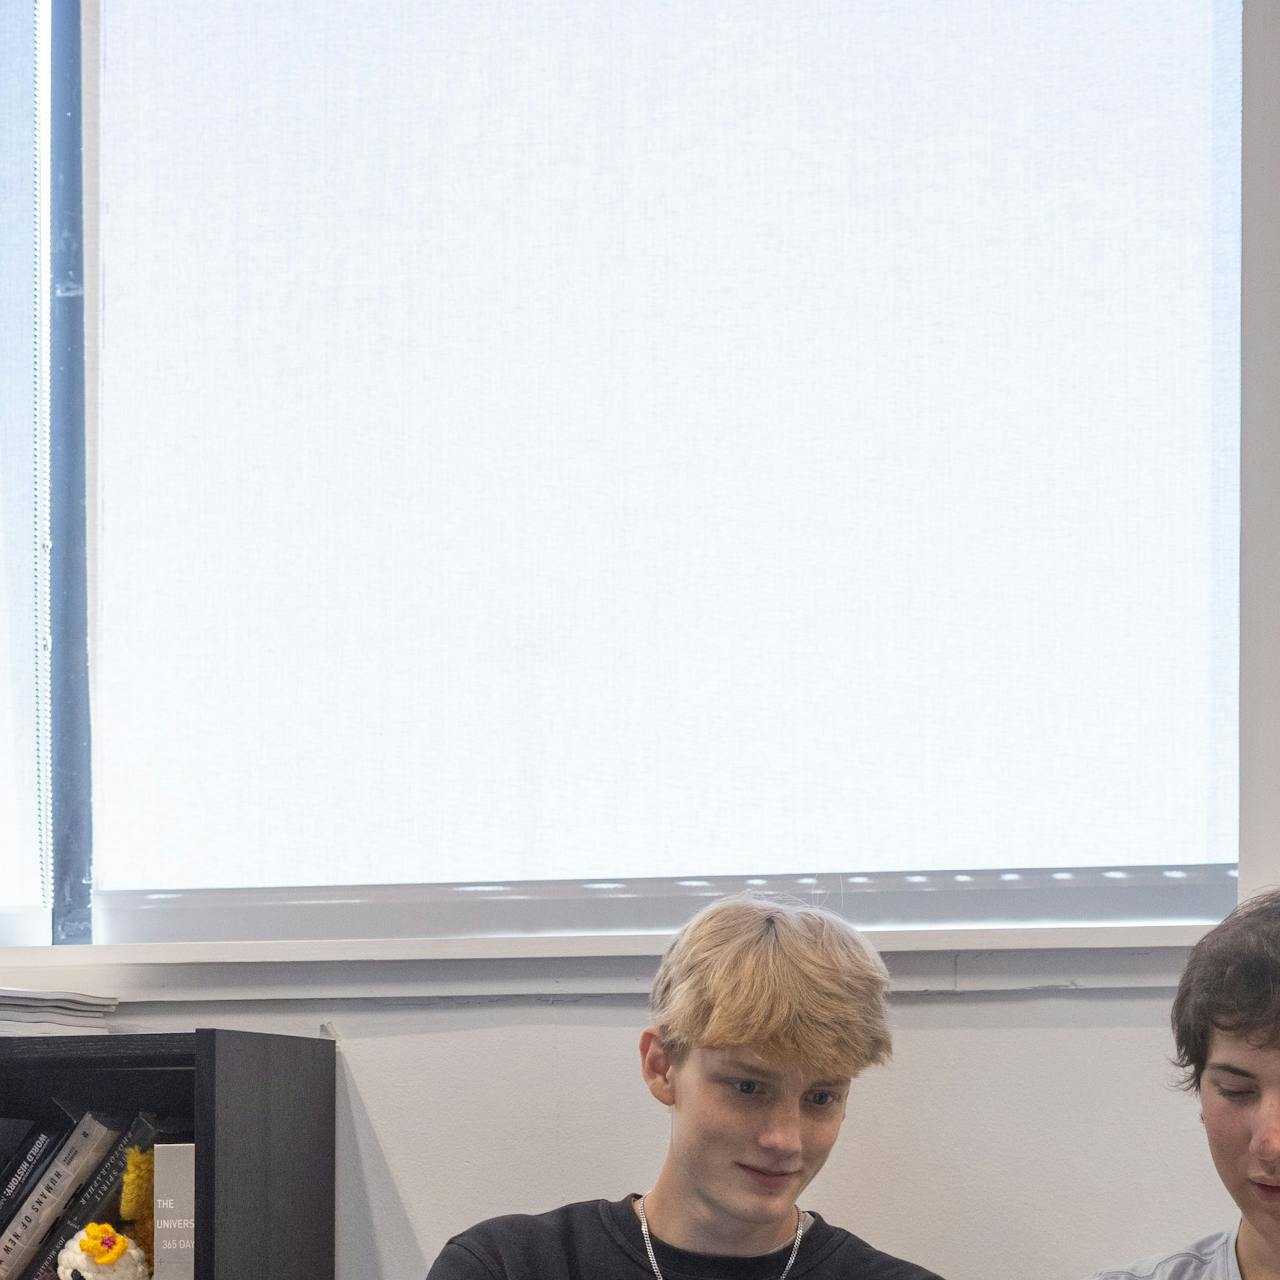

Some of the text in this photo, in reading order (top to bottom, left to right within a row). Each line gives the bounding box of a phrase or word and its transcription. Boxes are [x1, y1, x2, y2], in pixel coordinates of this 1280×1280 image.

[26, 1132, 48, 1164] WORLD
[4, 1163, 30, 1198] HISTORY:
[79, 1132, 132, 1206] PHOTOGRAPHER
[32, 1170, 62, 1213] HUMANS
[94, 1169, 119, 1202] SPIRIT
[156, 1199, 174, 1210] THE
[22, 1214, 33, 1231] OF
[156, 1218, 195, 1230] UNIVERS
[3, 1230, 22, 1256] NEW
[54, 1236, 66, 1249] JON
[162, 1239, 195, 1250] 365 DAY
